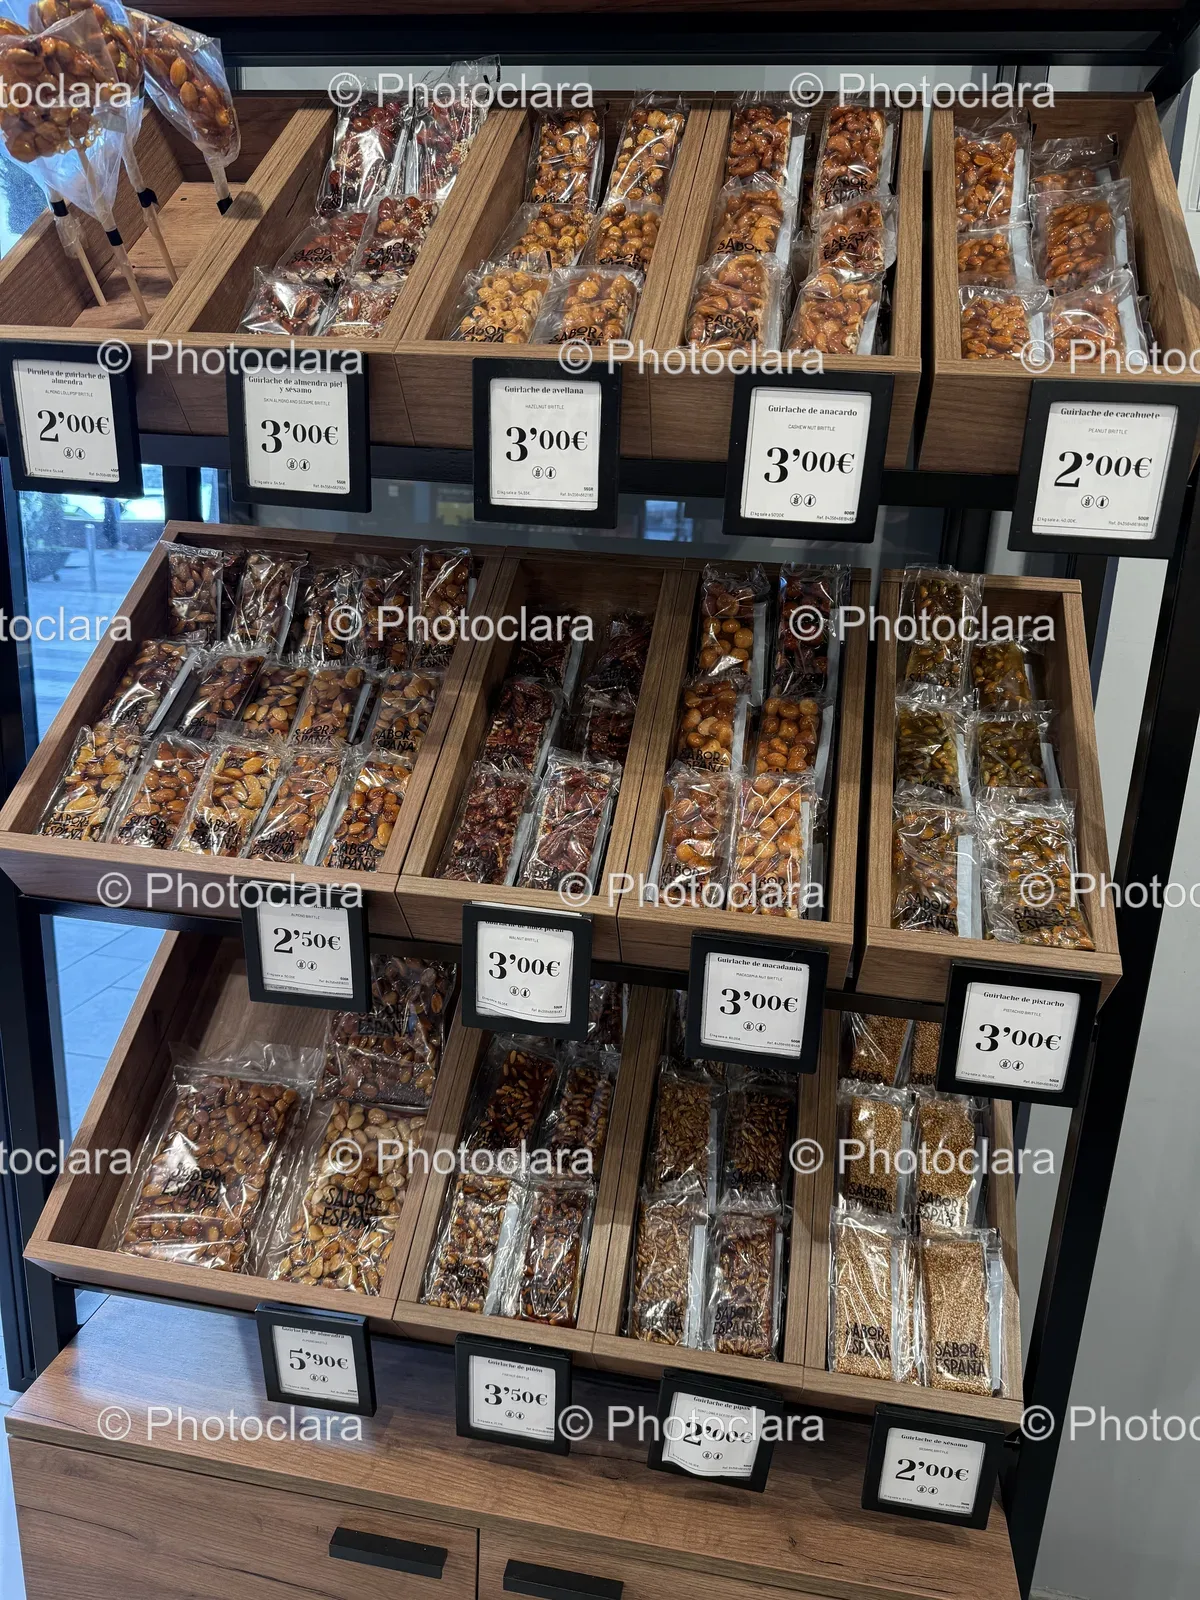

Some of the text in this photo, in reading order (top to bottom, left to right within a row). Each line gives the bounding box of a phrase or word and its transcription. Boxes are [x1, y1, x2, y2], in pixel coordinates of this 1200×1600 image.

[27, 367, 54, 377] Piruleta
[64, 371, 97, 380] guirlache
[97, 372, 106, 380] de
[51, 377, 84, 386] almendra
[248, 376, 283, 385] Guirlache
[293, 379, 328, 387] almendra
[329, 381, 343, 389] piel
[285, 386, 312, 394] sésamo
[504, 385, 541, 394] Guirlache
[541, 386, 551, 394] de
[768, 404, 858, 416] Guirlache de anacardo
[1061, 408, 1102, 417] Guirlache
[1115, 411, 1160, 419] cacahuete
[717, 956, 751, 966] Guirlache
[762, 962, 803, 972] macadamia
[983, 991, 1020, 1002] Guirlache
[1032, 997, 1065, 1008] pistacho
[325, 1187, 376, 1213] SABOR
[935, 1341, 978, 1359] SABOR
[487, 1359, 516, 1369] Guirlache
[936, 1357, 986, 1377] ESPAÑA
[693, 1396, 724, 1406] Guirlache
[733, 1403, 751, 1411] pipas
[901, 1434, 932, 1443] Guirlache
[943, 1440, 968, 1448] sésamo
